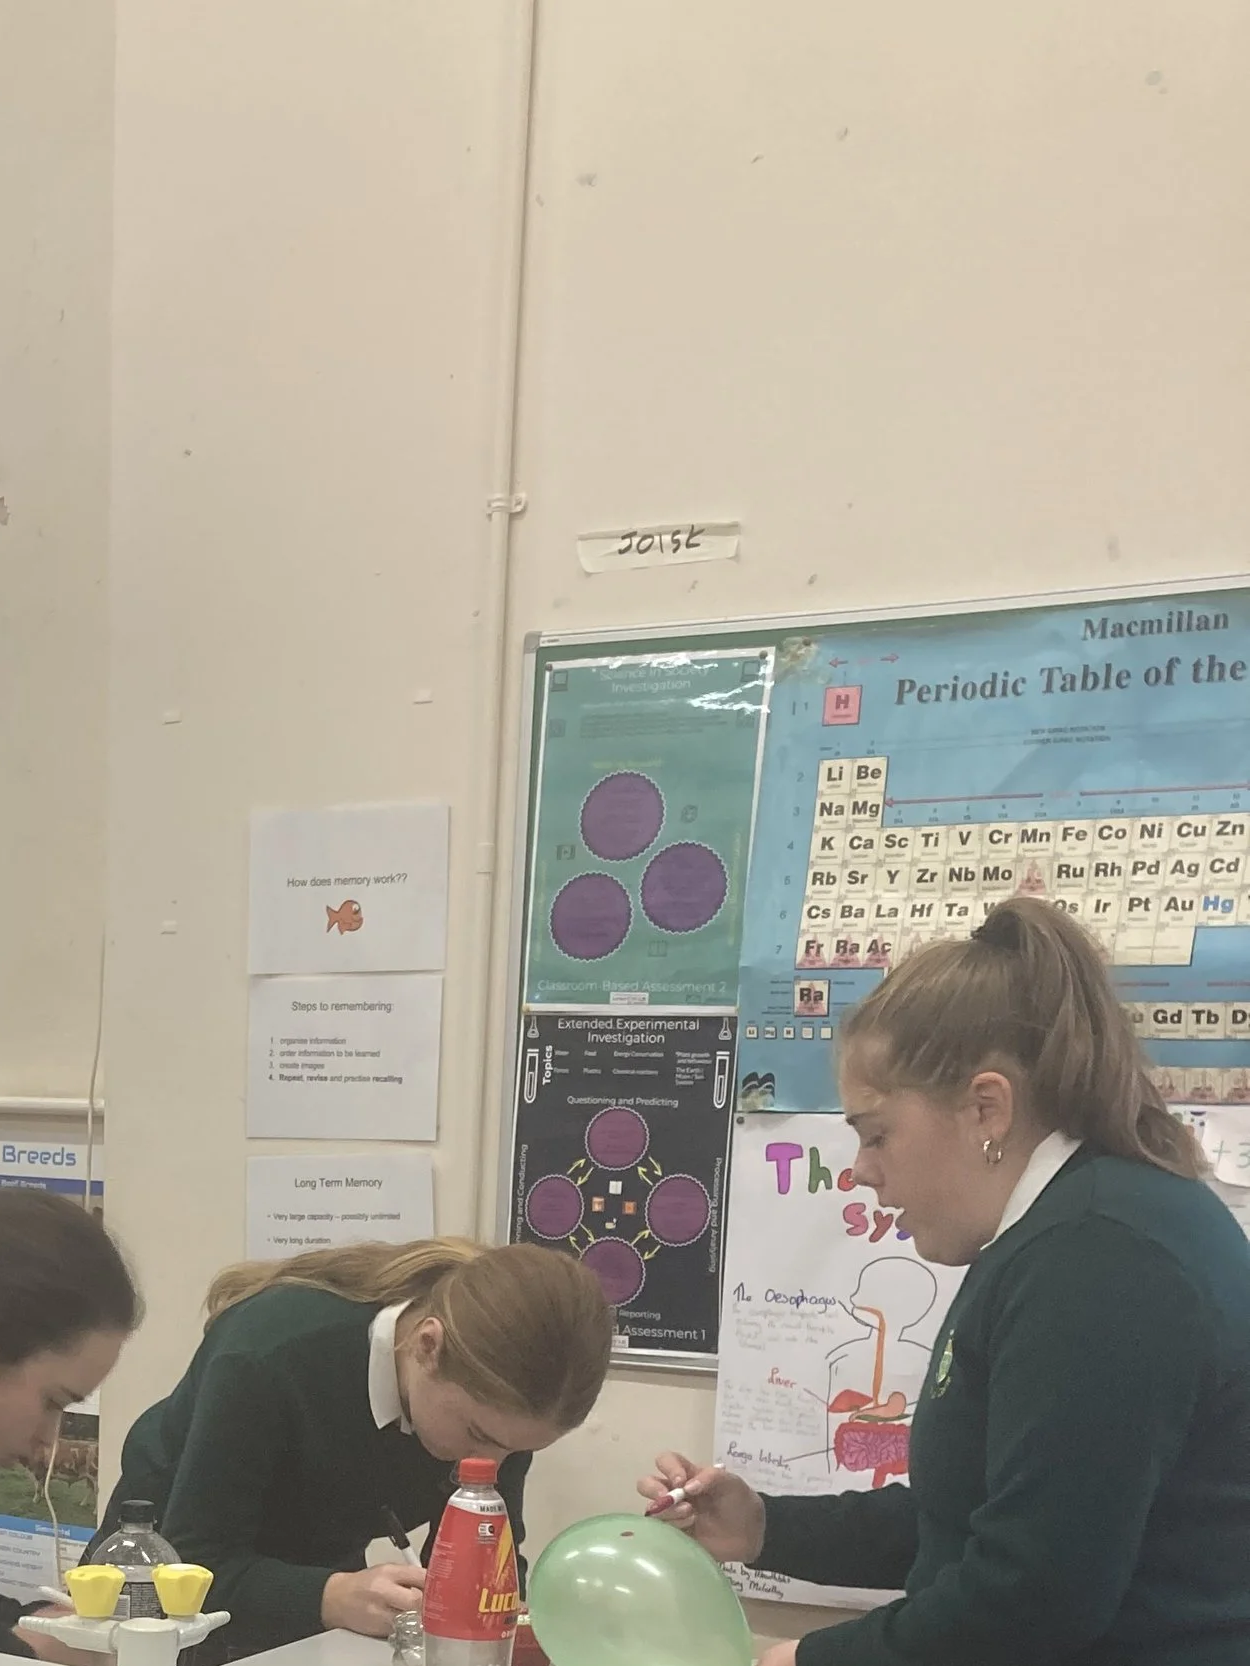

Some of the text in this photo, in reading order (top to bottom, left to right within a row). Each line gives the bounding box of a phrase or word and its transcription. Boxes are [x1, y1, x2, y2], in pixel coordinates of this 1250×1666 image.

[1081, 610, 1230, 641] Macmillan
[612, 679, 691, 694] Investigation
[894, 654, 1247, 706] Periodic Table of the
[835, 694, 850, 710] H
[827, 765, 882, 782] Li Be
[819, 802, 845, 817] Na
[852, 800, 880, 817] Mg
[820, 820, 1245, 850] K Ca Sc Ti V Cr Mn Fe Co Ni Cu Zn
[286, 872, 408, 888] How does memory work??
[811, 858, 1240, 886] Rb Sr Y Zr Nb Mo Ru Rh Pd Ag Cd
[806, 905, 831, 919] Cs
[840, 905, 865, 919] Ba
[875, 904, 898, 918] La
[910, 903, 933, 917] Hf
[945, 902, 969, 917] Ta
[1094, 899, 1111, 913] Ir
[1128, 897, 1151, 912] Pt
[1164, 896, 1194, 911] Au
[1202, 895, 1234, 913] Hg
[805, 939, 892, 955] Fr Ra Ac
[642, 980, 715, 993] Assessment
[719, 980, 727, 993] 2
[799, 987, 824, 1002] Ra
[291, 1001, 392, 1014] Steps to remembering
[557, 1017, 700, 1033] Extended Experimental
[1153, 1009, 1182, 1025] Gd
[1191, 1009, 1220, 1025] Tb
[587, 1031, 665, 1045] Investigation
[542, 1044, 554, 1086] Topics
[567, 1095, 679, 1108] Questioning and Predicting
[2, 1145, 77, 1167] Breeds
[294, 1177, 383, 1190] Long Term Memory
[619, 1309, 661, 1321] Reporting
[623, 1325, 706, 1341] Assessment 1
